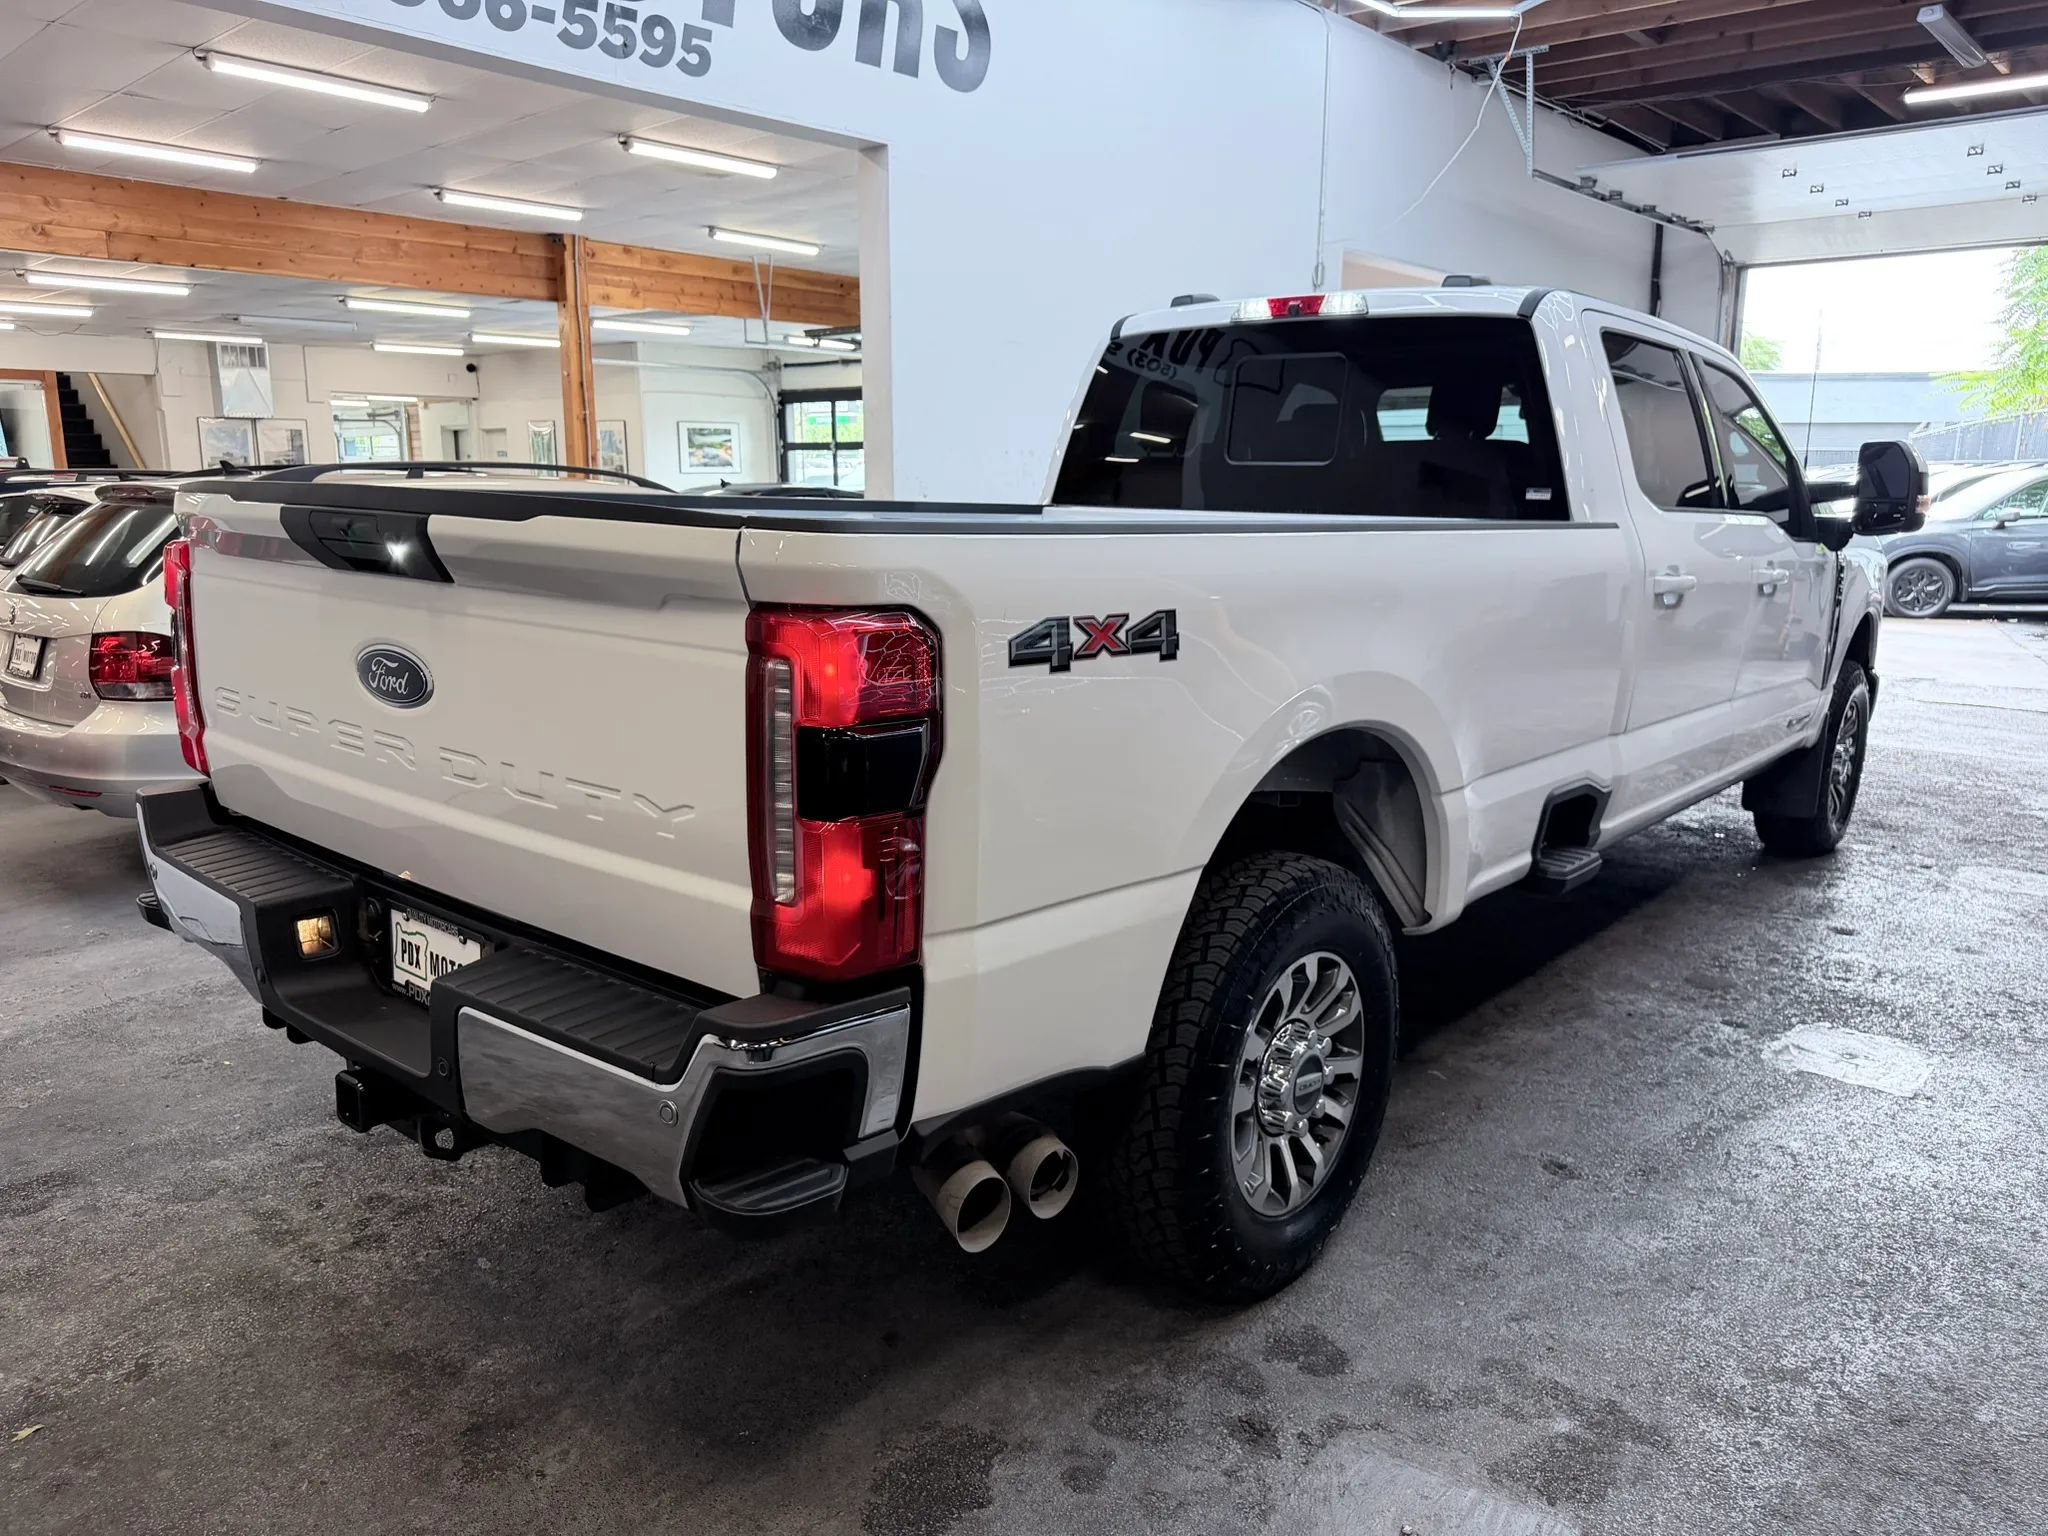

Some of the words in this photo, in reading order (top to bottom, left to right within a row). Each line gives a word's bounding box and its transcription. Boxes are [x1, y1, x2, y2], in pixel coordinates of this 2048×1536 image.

[369, 656, 409, 695] Ford
[214, 686, 417, 771] SUPER
[439, 746, 696, 838] DUTY
[401, 937, 421, 970] PDX
